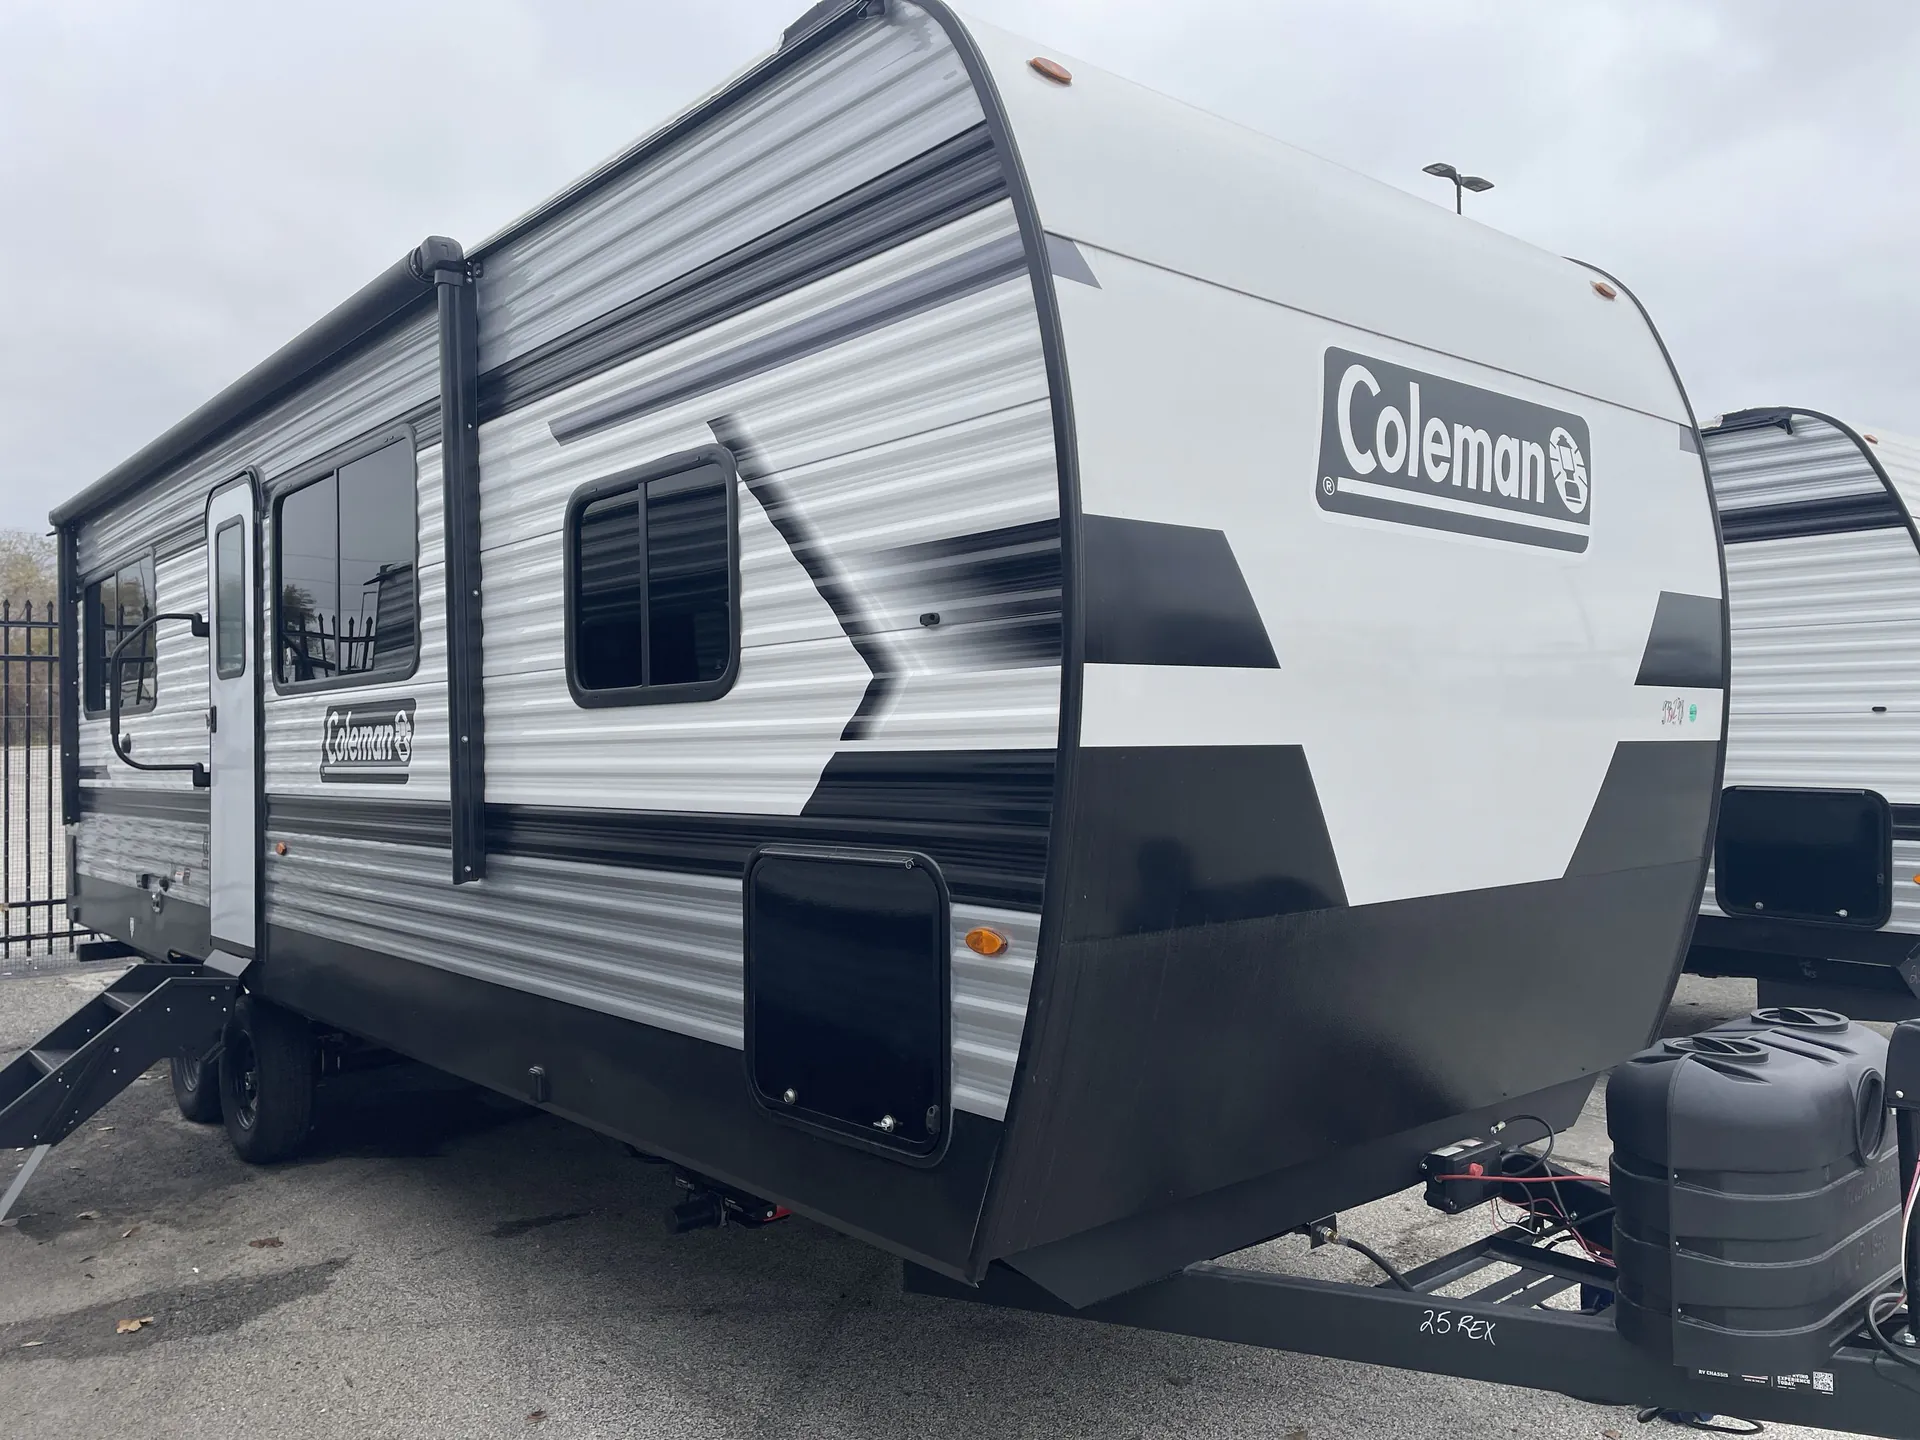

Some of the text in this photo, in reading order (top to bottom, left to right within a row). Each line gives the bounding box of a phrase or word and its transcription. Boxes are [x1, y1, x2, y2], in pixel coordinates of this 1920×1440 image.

[1338, 364, 1545, 503] Coleman
[325, 711, 394, 764] Coleman
[1420, 1310, 1496, 1346] 25 REX
[1706, 1370, 1729, 1378] CHASSIS
[1777, 1375, 1811, 1385] EXPERIENCE
